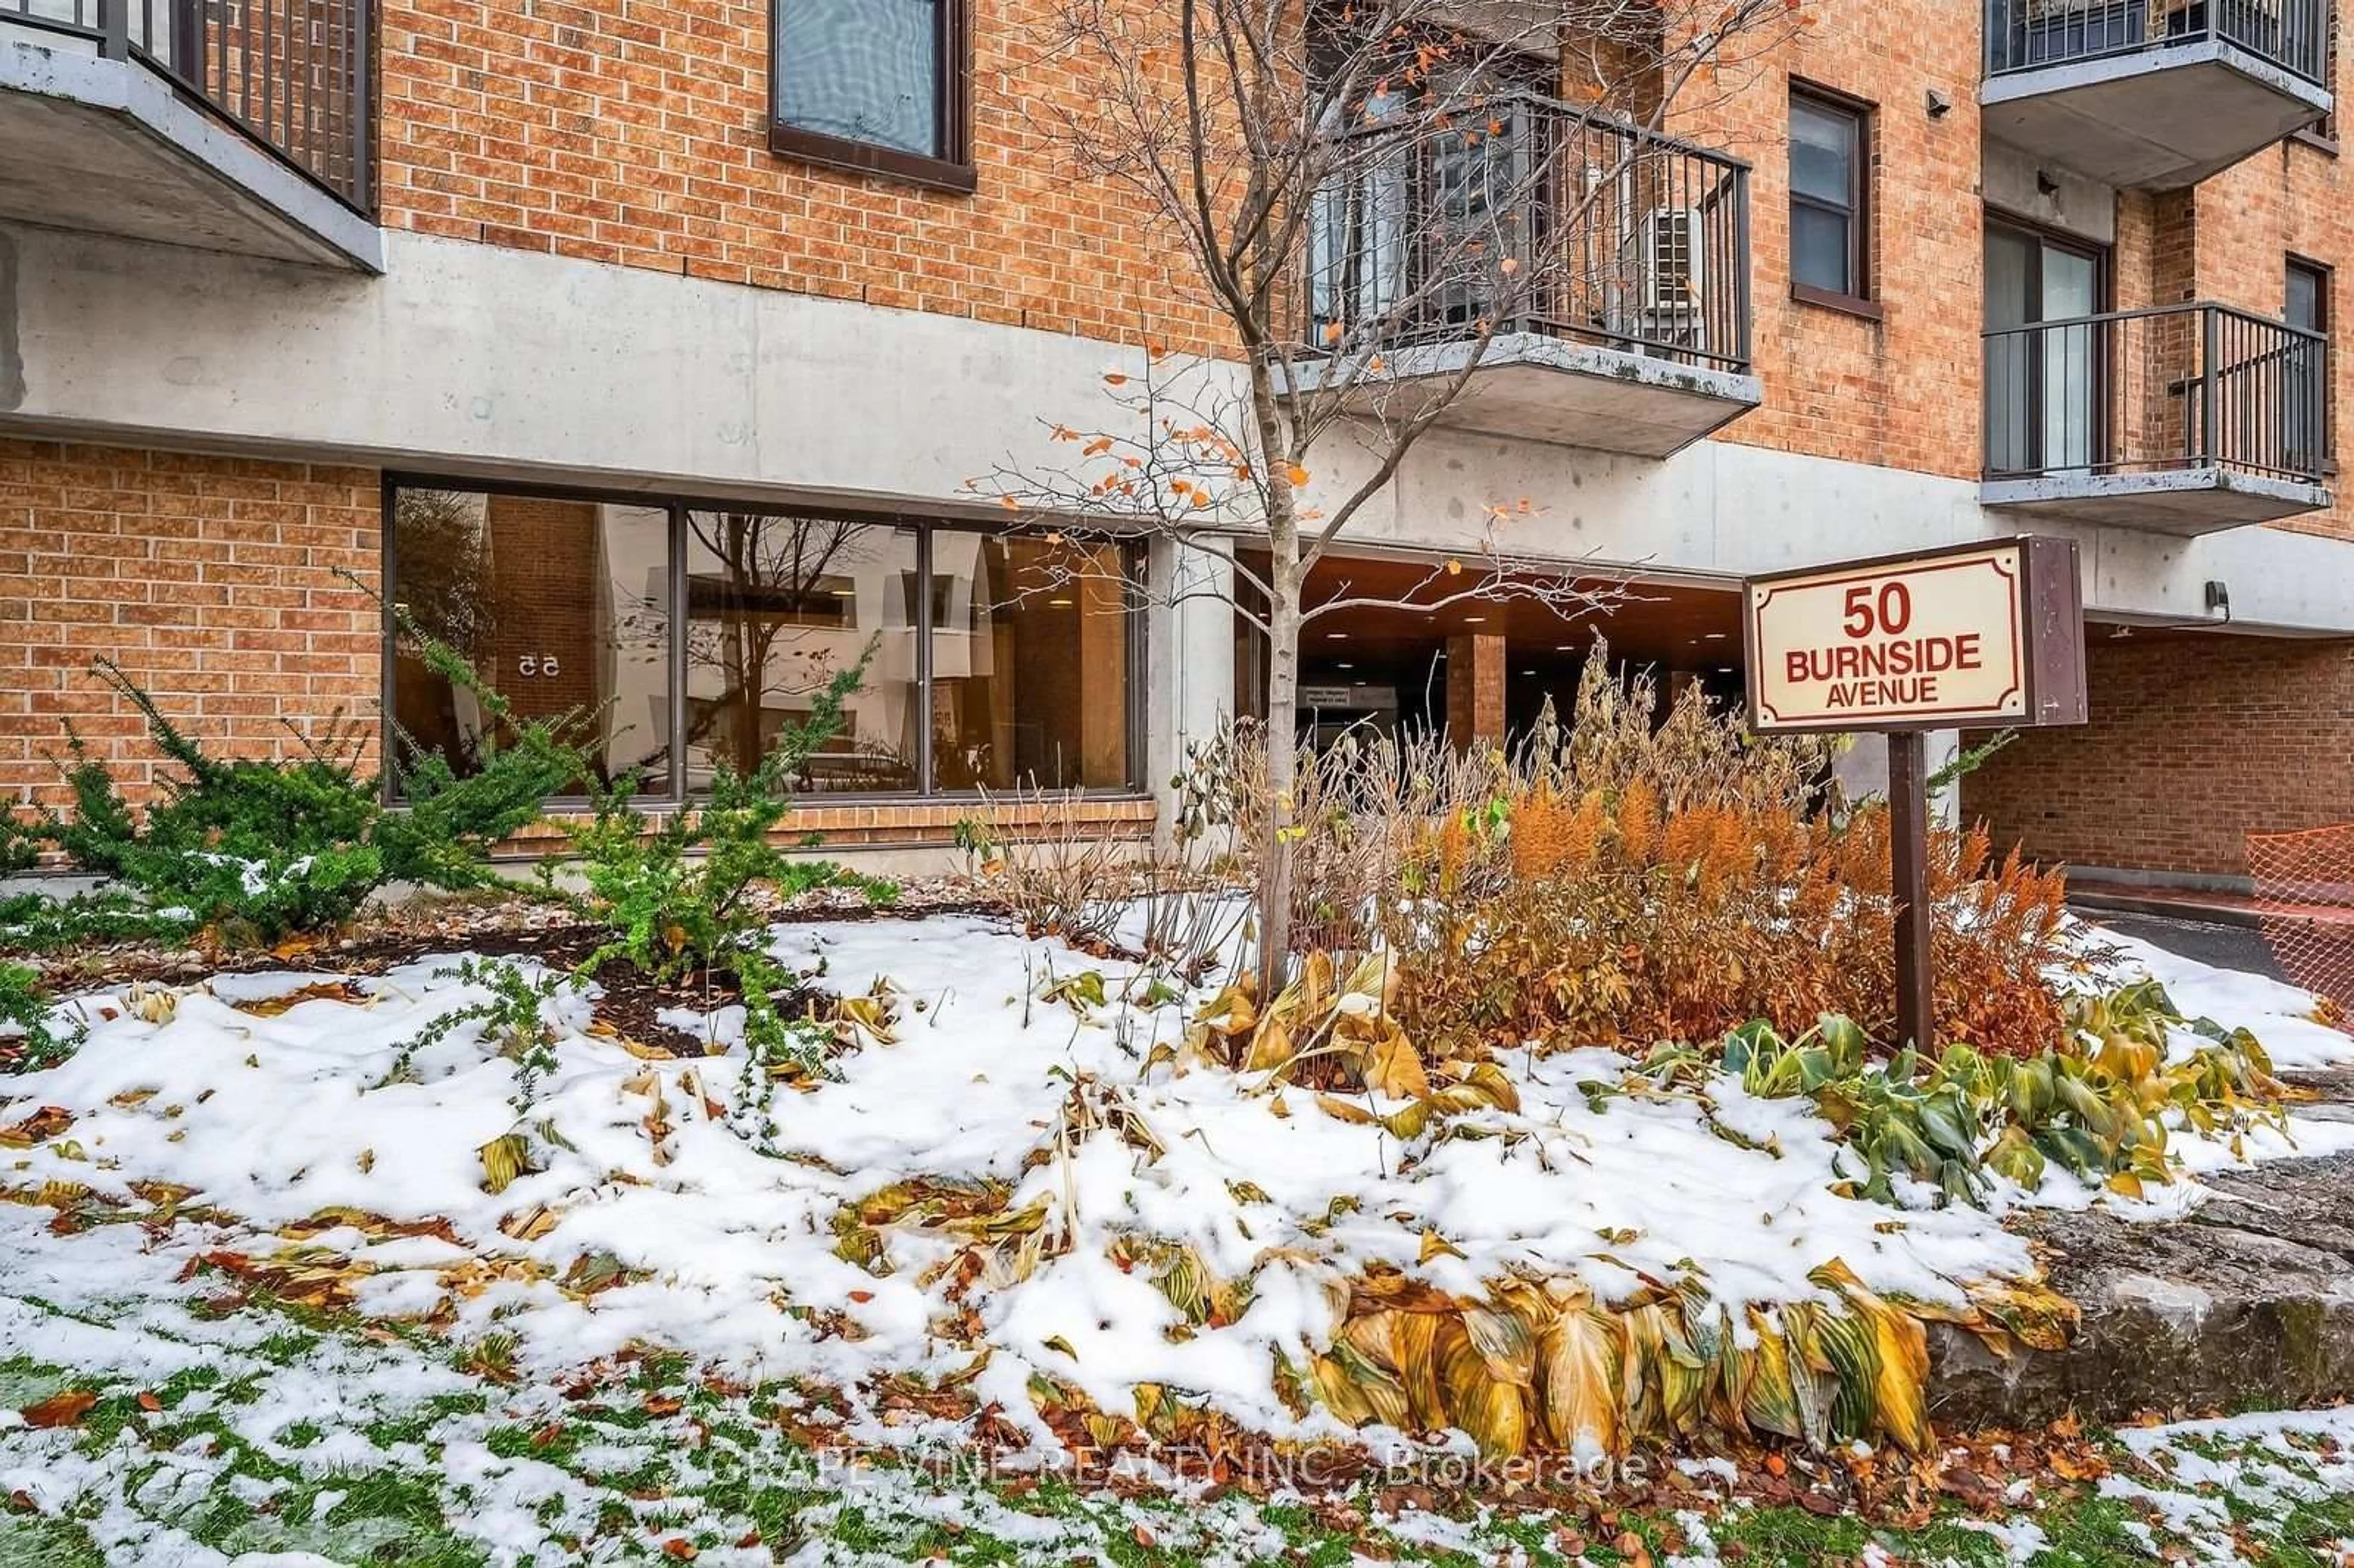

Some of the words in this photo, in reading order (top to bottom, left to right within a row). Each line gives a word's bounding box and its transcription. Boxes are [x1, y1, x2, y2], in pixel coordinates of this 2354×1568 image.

[1843, 581, 1911, 639] 50
[1786, 633, 1982, 683] BURNSIDE
[1826, 676, 1938, 709] AVENUE
